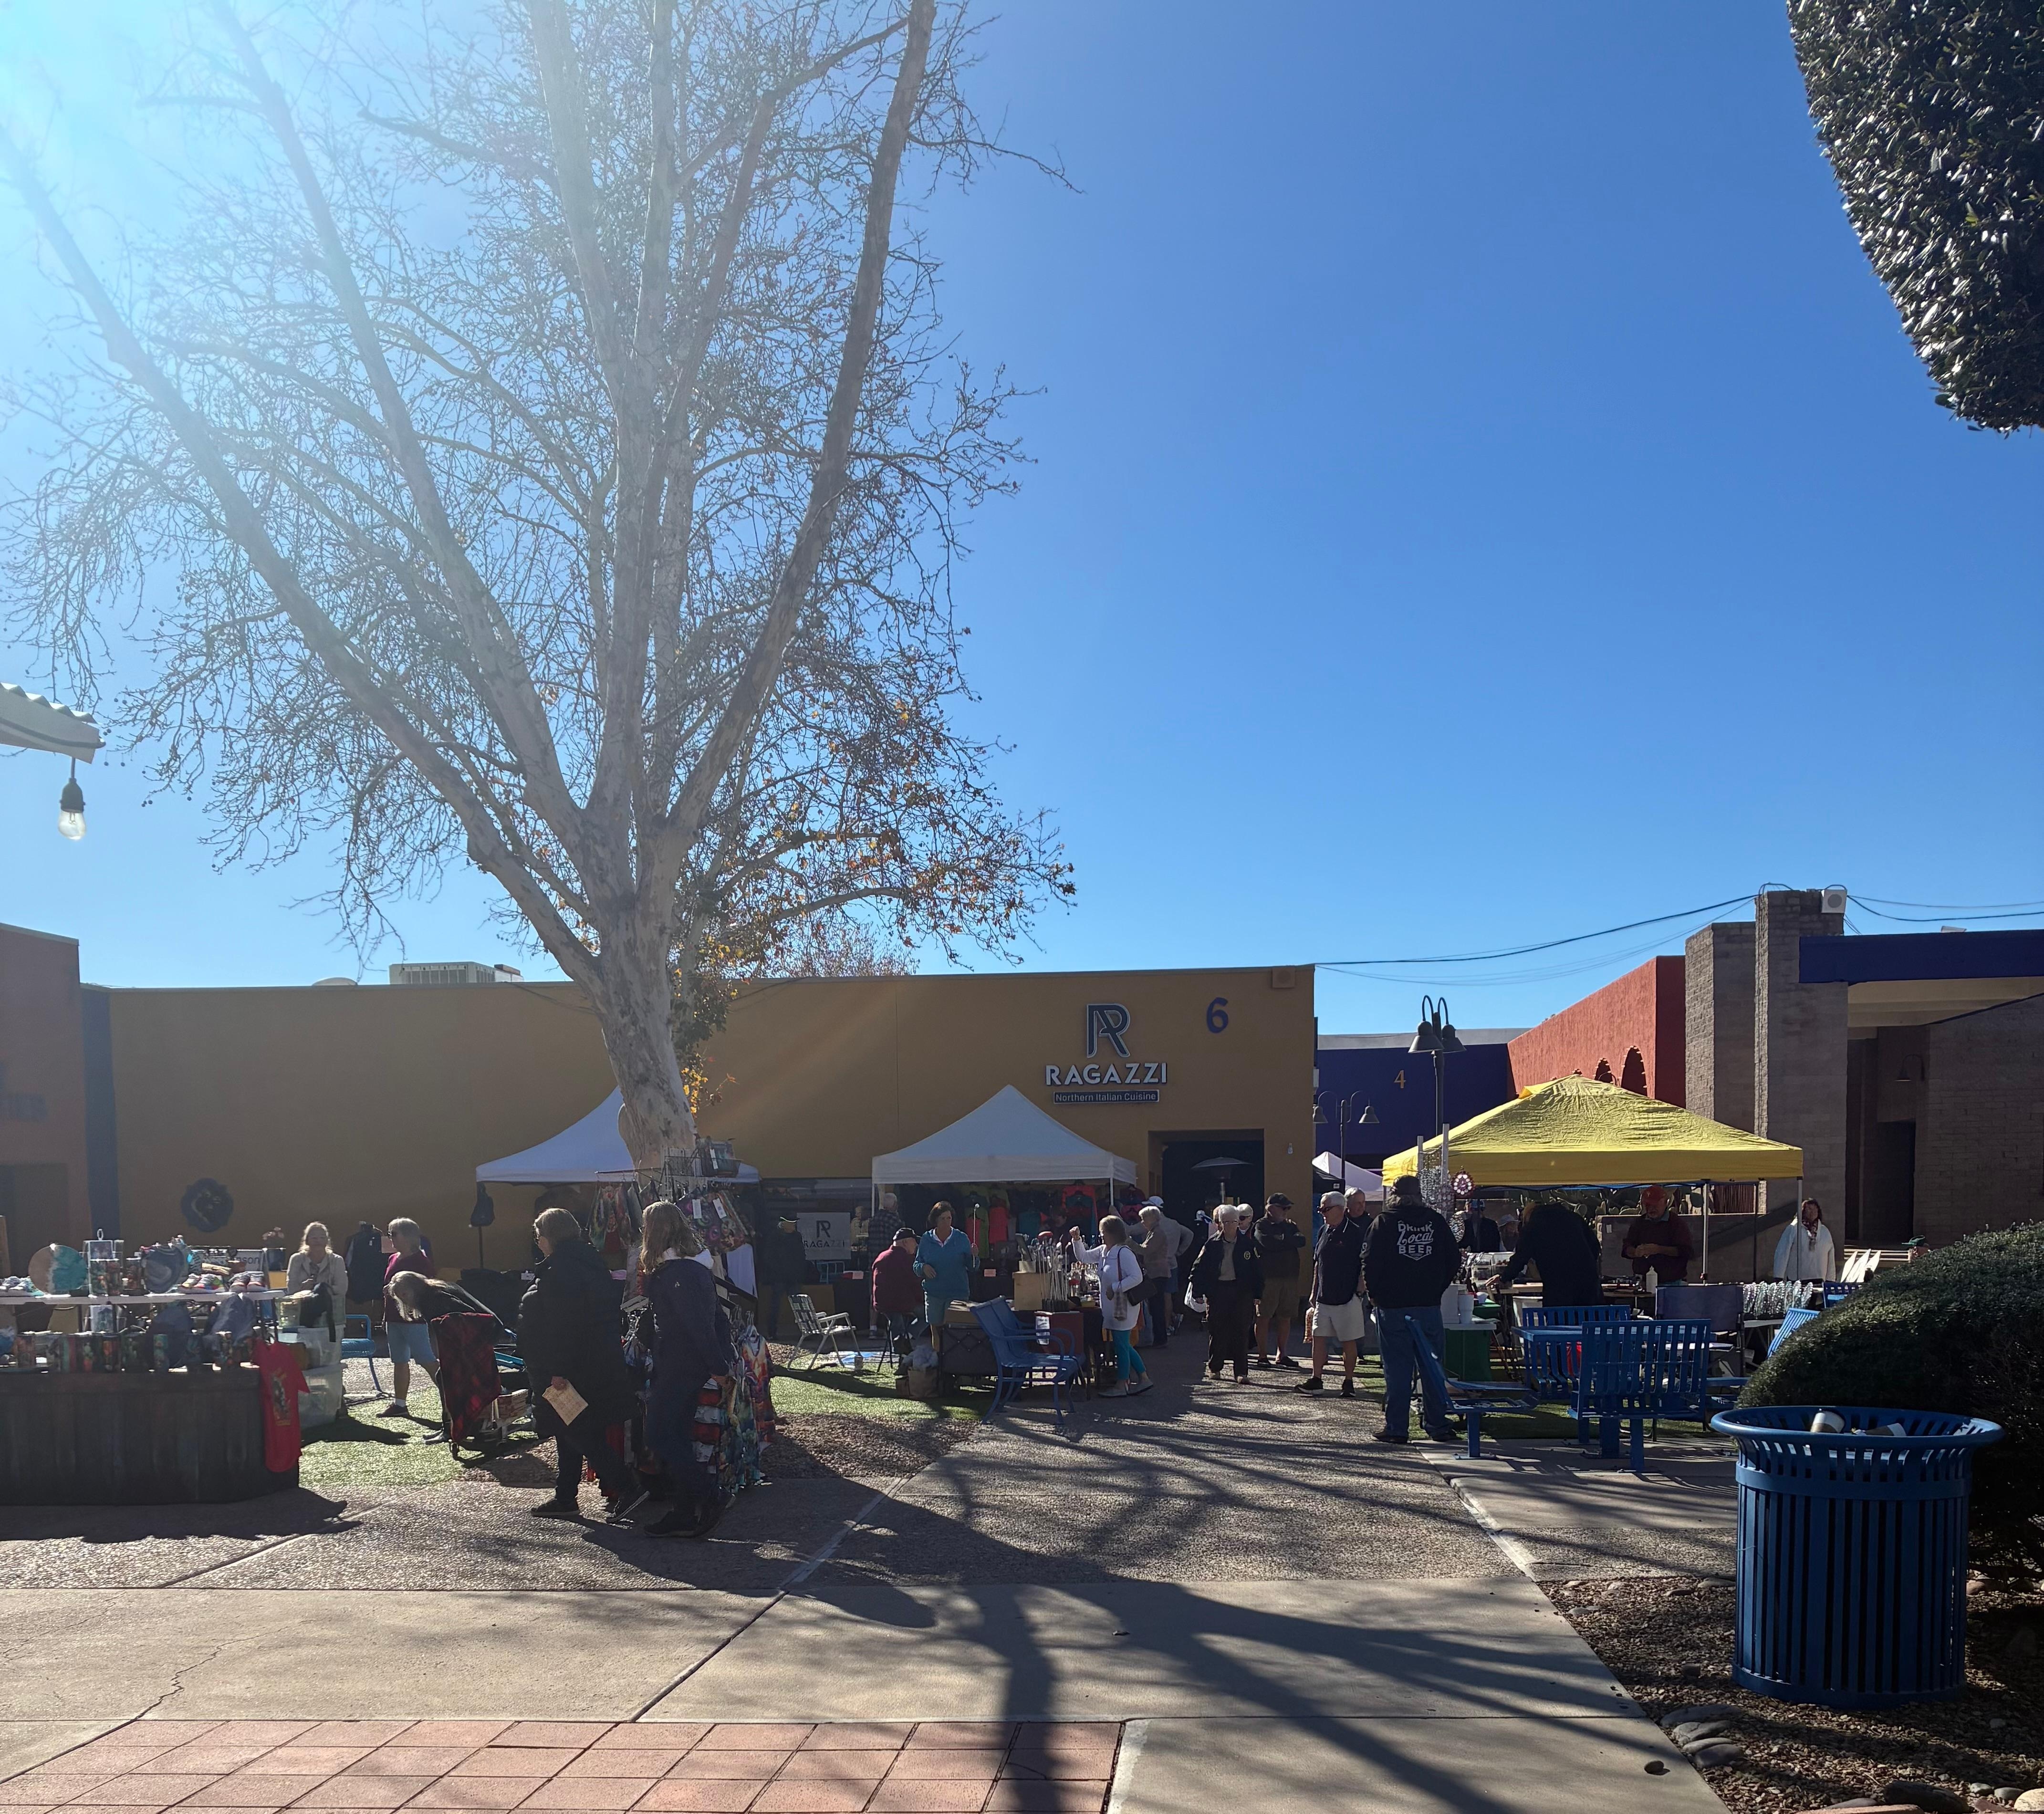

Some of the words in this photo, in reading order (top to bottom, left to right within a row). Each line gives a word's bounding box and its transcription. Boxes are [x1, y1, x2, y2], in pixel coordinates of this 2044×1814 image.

[1207, 997, 1228, 1033] 6
[1045, 1062, 1167, 1085] RAGAZZI
[1394, 1070, 1406, 1088] 4
[1056, 1093, 1094, 1102] Northern
[1096, 1093, 1122, 1101] Italian
[1124, 1092, 1156, 1101] Cuisine
[1399, 1245, 1432, 1254] BEER
